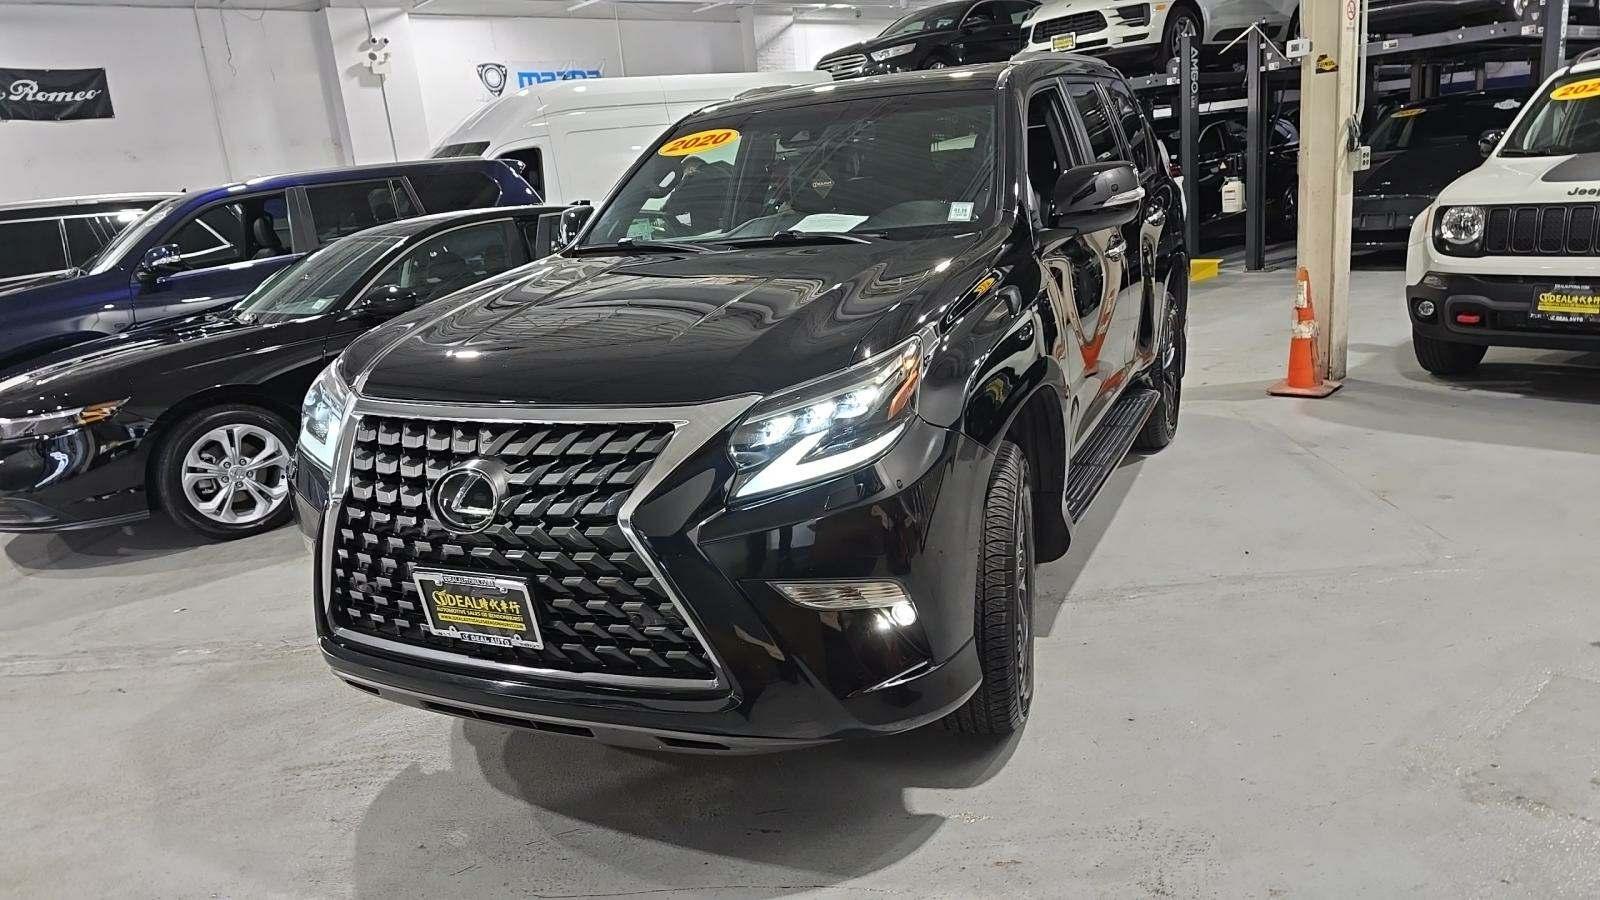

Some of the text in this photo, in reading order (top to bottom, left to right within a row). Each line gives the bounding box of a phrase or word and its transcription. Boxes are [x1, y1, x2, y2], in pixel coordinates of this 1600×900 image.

[1190, 46, 1199, 94] AMGO
[8, 79, 102, 102] Romeo
[665, 132, 732, 152] 2020
